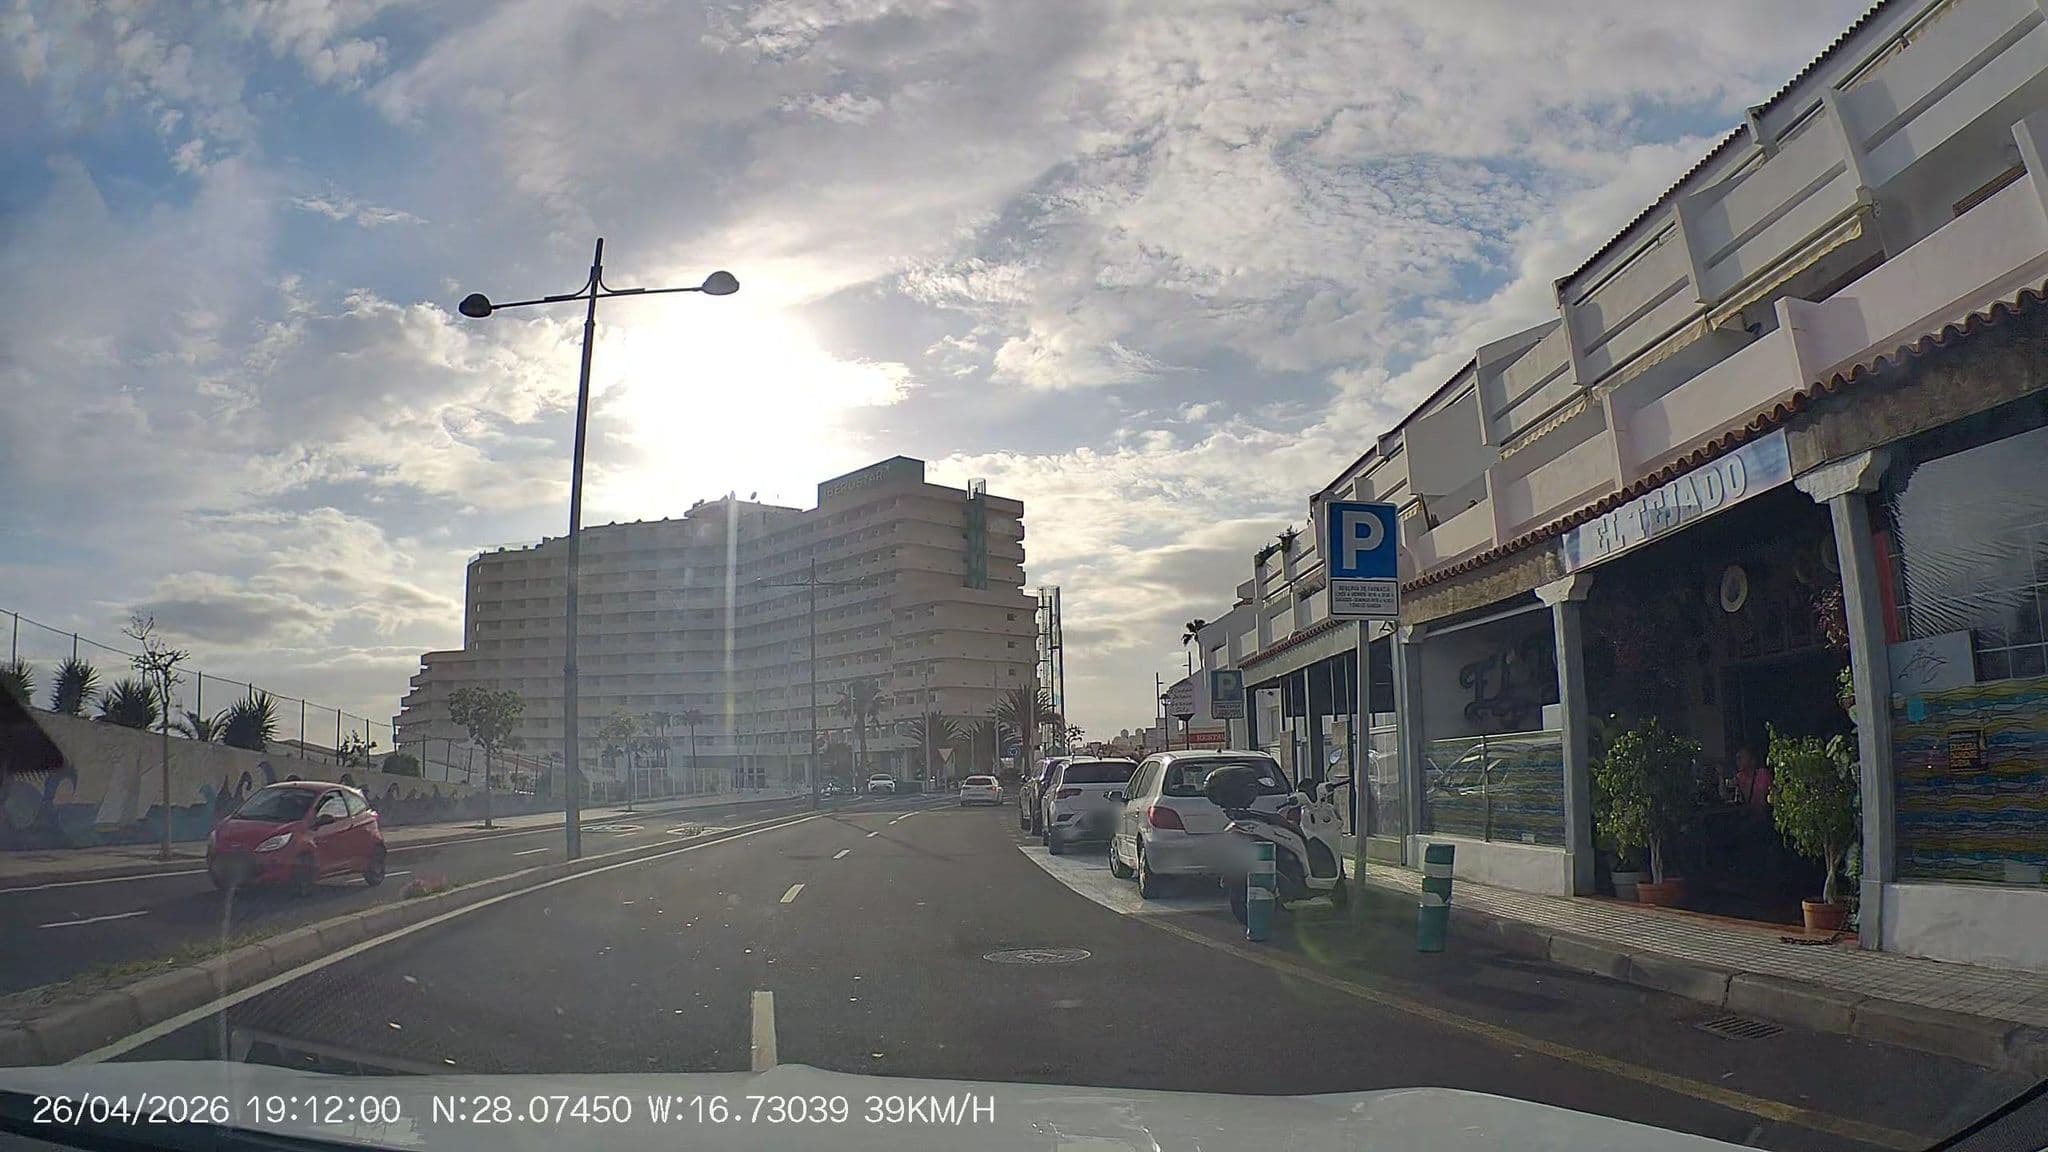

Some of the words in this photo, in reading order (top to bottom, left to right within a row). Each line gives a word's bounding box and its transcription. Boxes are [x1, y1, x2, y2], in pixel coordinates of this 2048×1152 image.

[1590, 513, 1626, 554] EL
[1626, 454, 1748, 542] TEJADO
[1342, 510, 1385, 570] P
[1217, 673, 1237, 699] P
